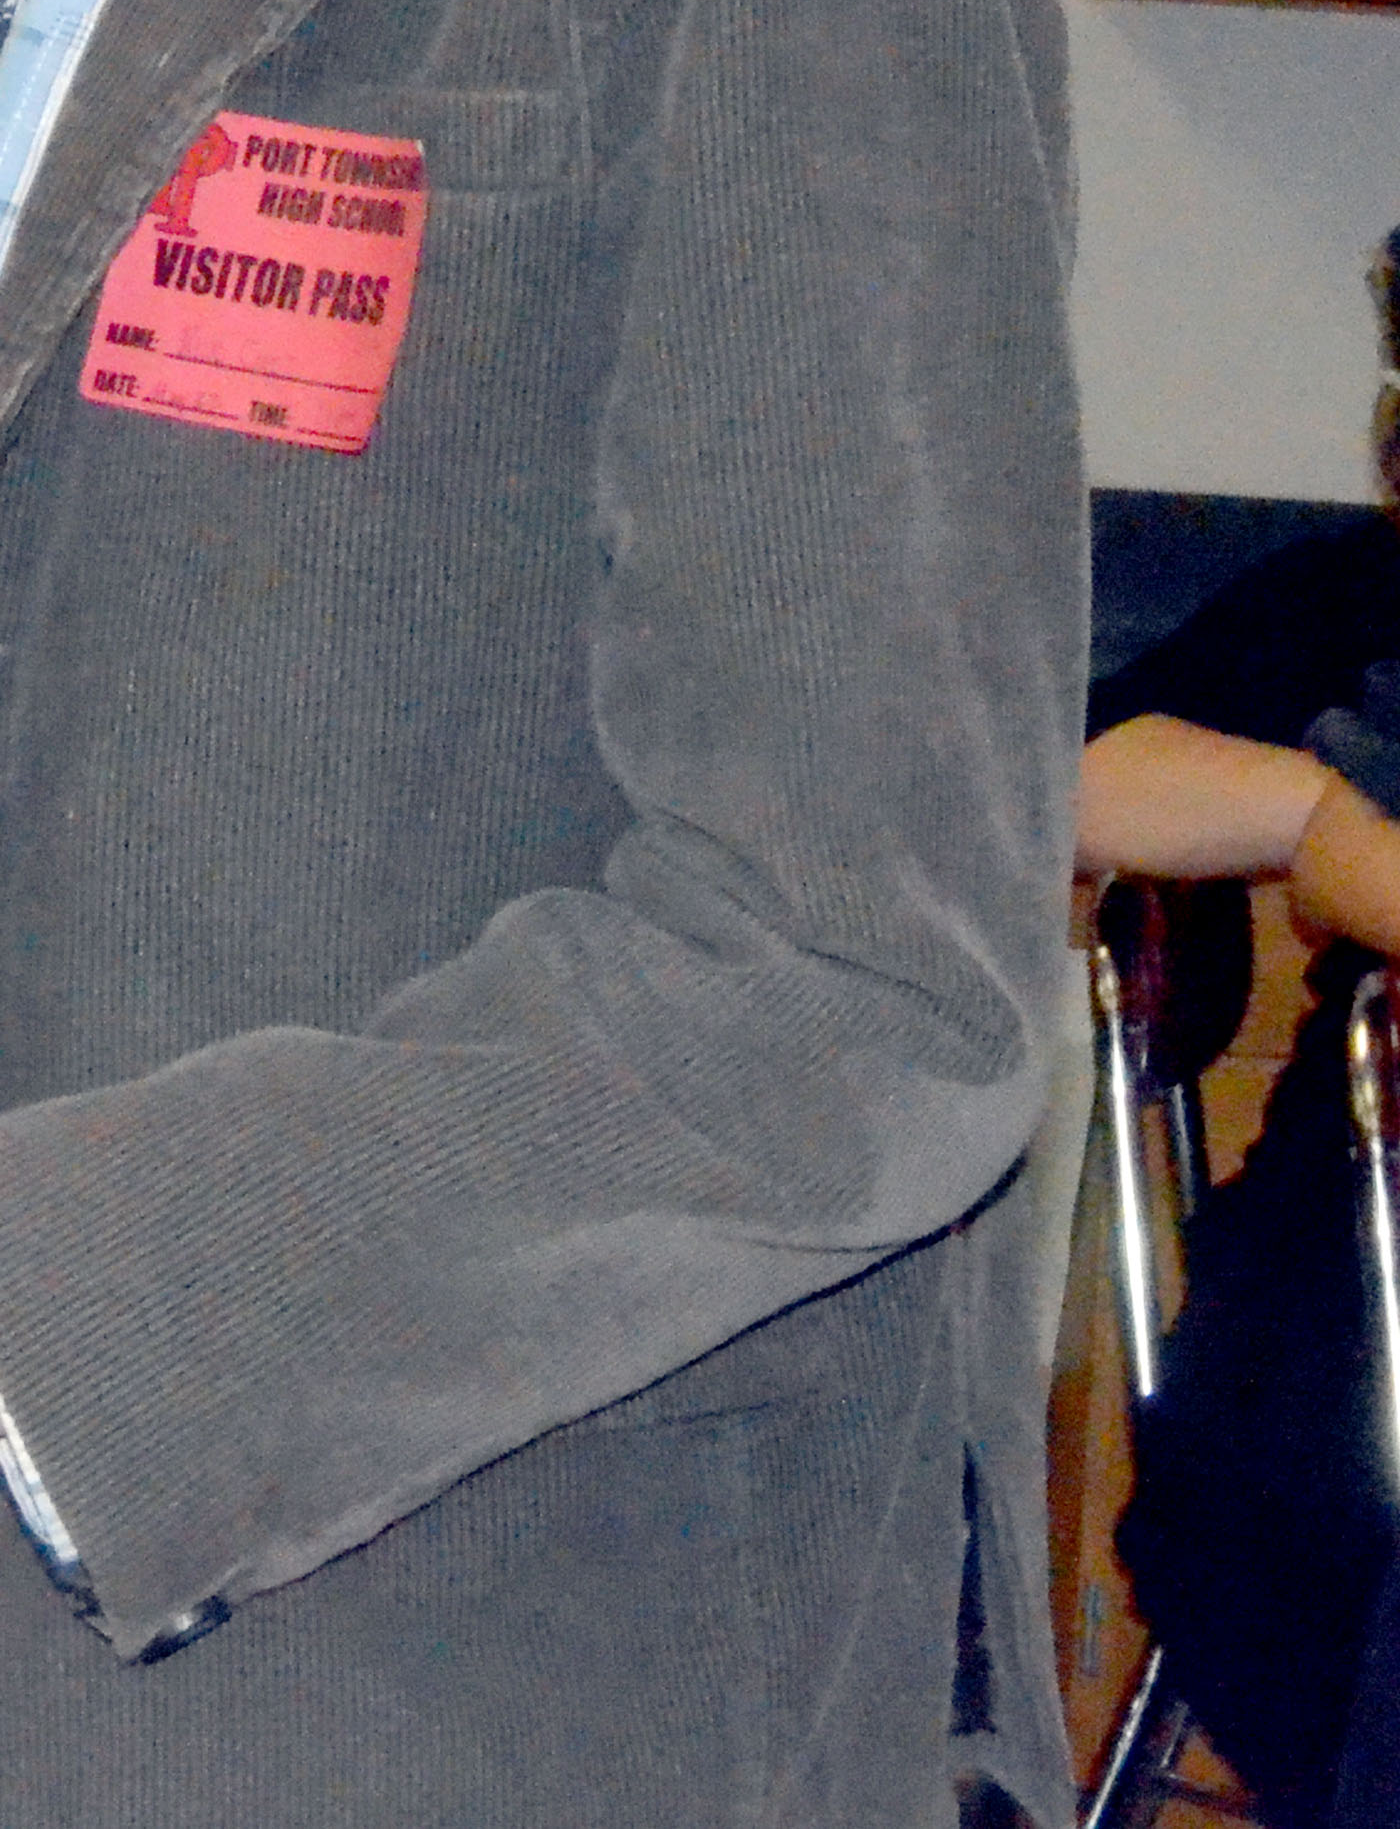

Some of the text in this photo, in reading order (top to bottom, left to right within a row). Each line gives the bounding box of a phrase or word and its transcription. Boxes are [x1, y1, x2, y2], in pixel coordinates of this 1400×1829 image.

[243, 135, 317, 177] PORT
[258, 182, 325, 224] HIGH
[153, 239, 390, 326] VISITOR PASS
